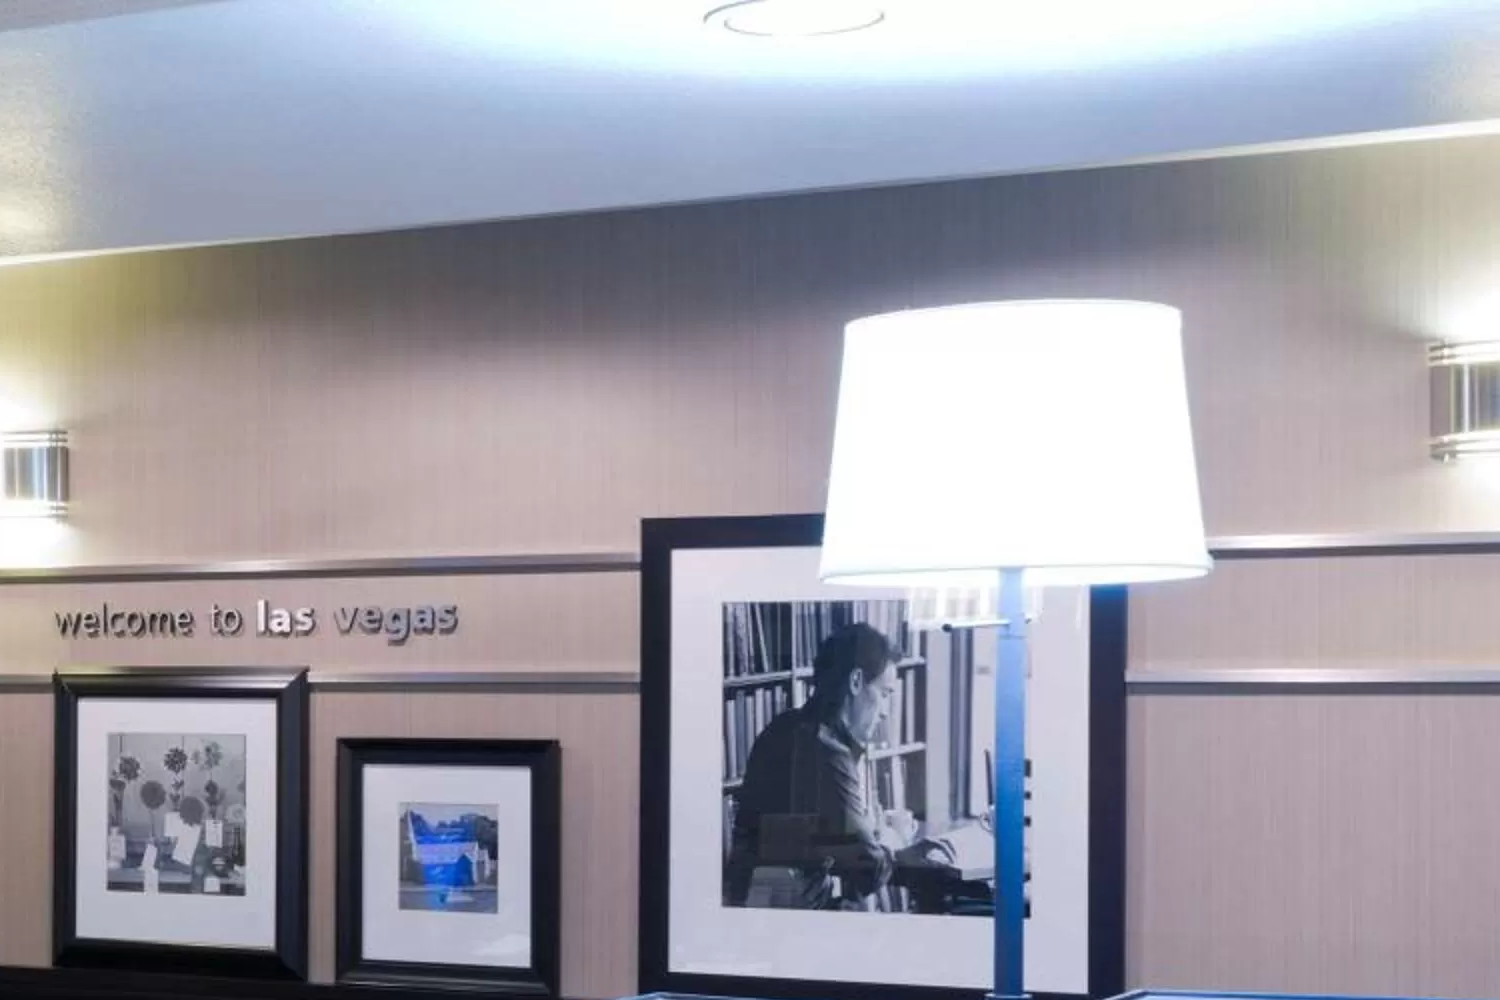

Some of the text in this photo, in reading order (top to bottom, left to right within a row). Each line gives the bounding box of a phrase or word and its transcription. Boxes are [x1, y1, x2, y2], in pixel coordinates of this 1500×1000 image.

[54, 599, 460, 646] welcome to las vegas
